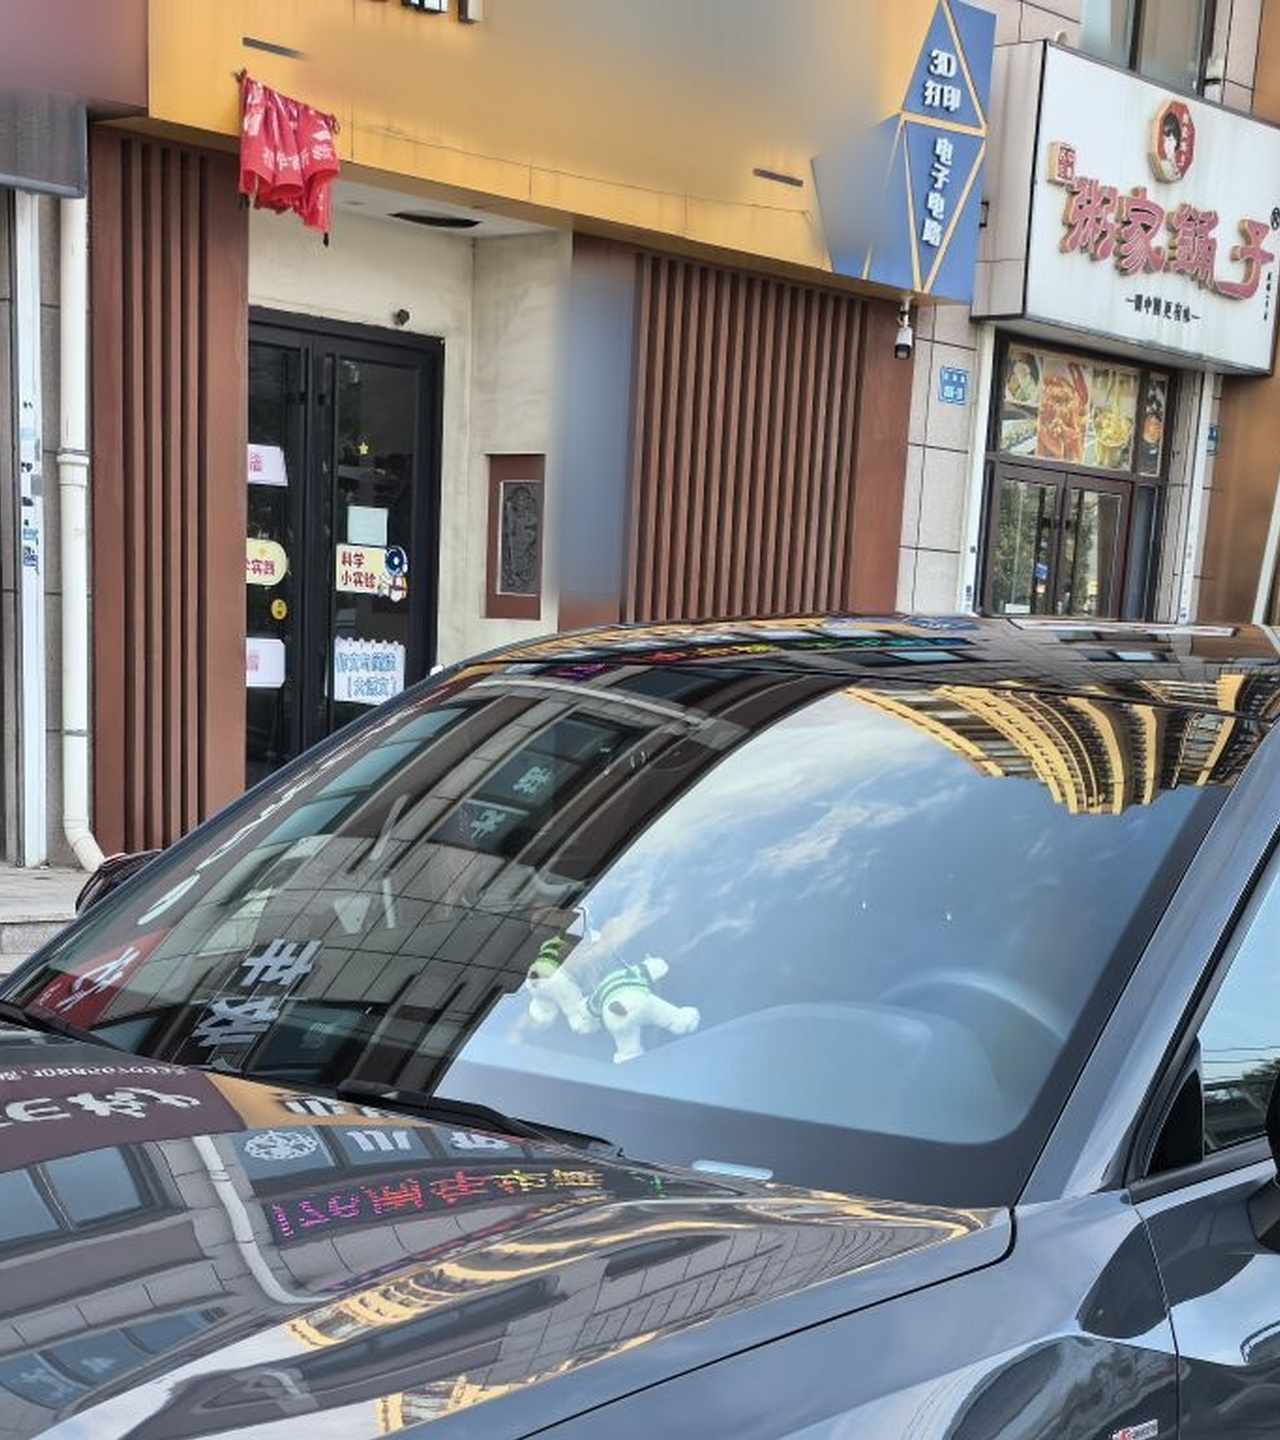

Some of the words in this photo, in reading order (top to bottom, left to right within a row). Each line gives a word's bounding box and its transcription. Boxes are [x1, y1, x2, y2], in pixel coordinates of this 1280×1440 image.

[929, 49, 958, 78] 3D
[923, 80, 962, 112] 打印
[921, 137, 954, 248] 电子电路
[340, 550, 366, 568] 科学
